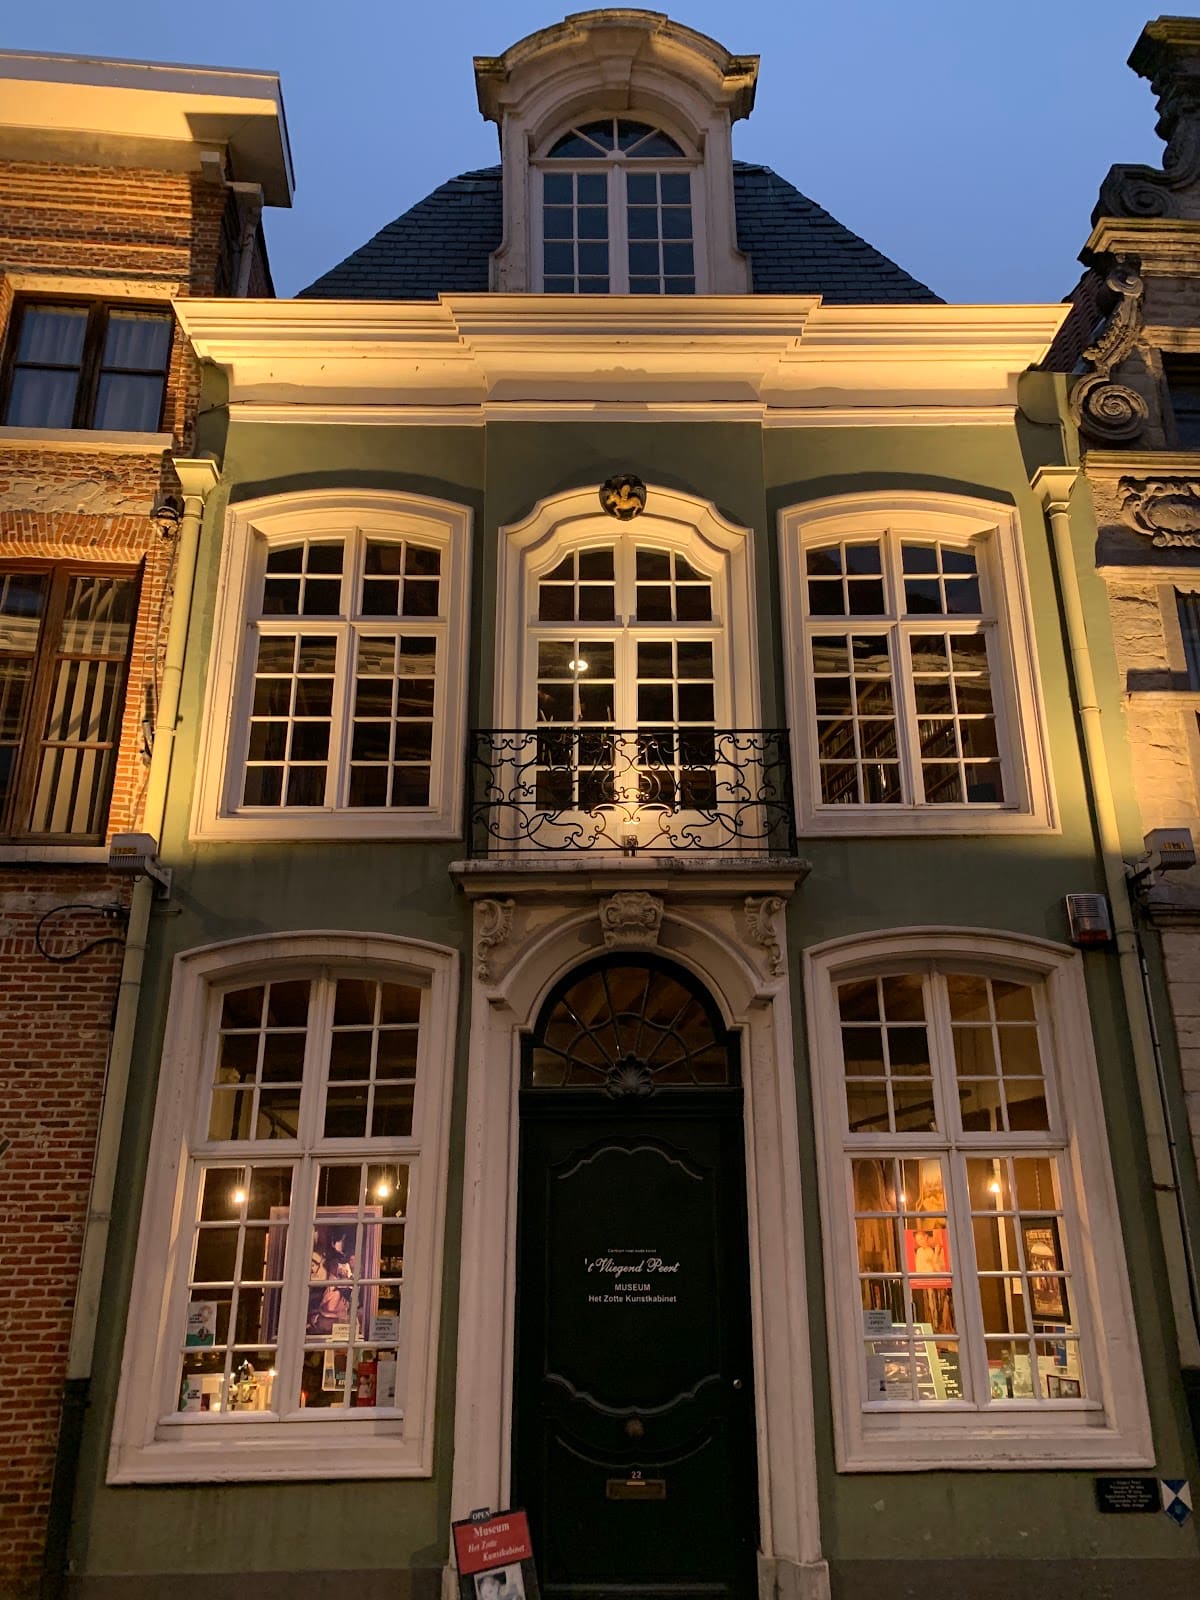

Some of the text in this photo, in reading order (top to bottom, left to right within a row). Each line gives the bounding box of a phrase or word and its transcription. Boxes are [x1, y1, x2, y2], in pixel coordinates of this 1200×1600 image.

[584, 1257, 680, 1278] 't Vliegend Peert
[614, 1283, 651, 1291] MUSEUM
[588, 1294, 677, 1303] Het Zotte Kunstkabinet
[631, 1470, 642, 1479] 22
[472, 1511, 490, 1520] OPEN
[473, 1522, 510, 1537] Museum
